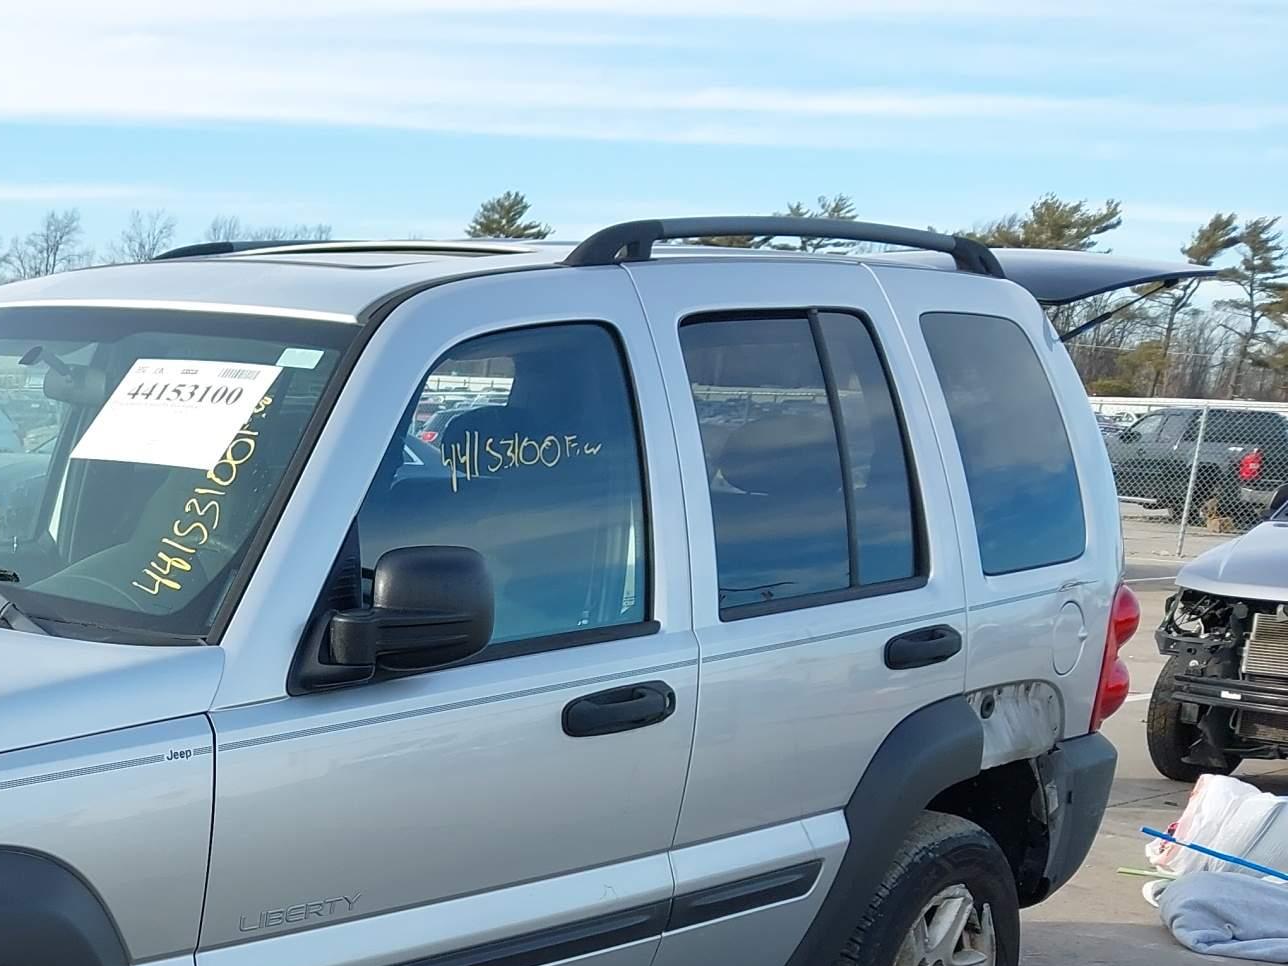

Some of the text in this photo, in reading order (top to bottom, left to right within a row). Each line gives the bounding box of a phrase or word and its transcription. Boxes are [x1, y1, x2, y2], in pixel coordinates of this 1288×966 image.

[127, 382, 244, 406] 44153100
[166, 748, 192, 761] Jeep
[238, 892, 362, 932] LIBERTY
